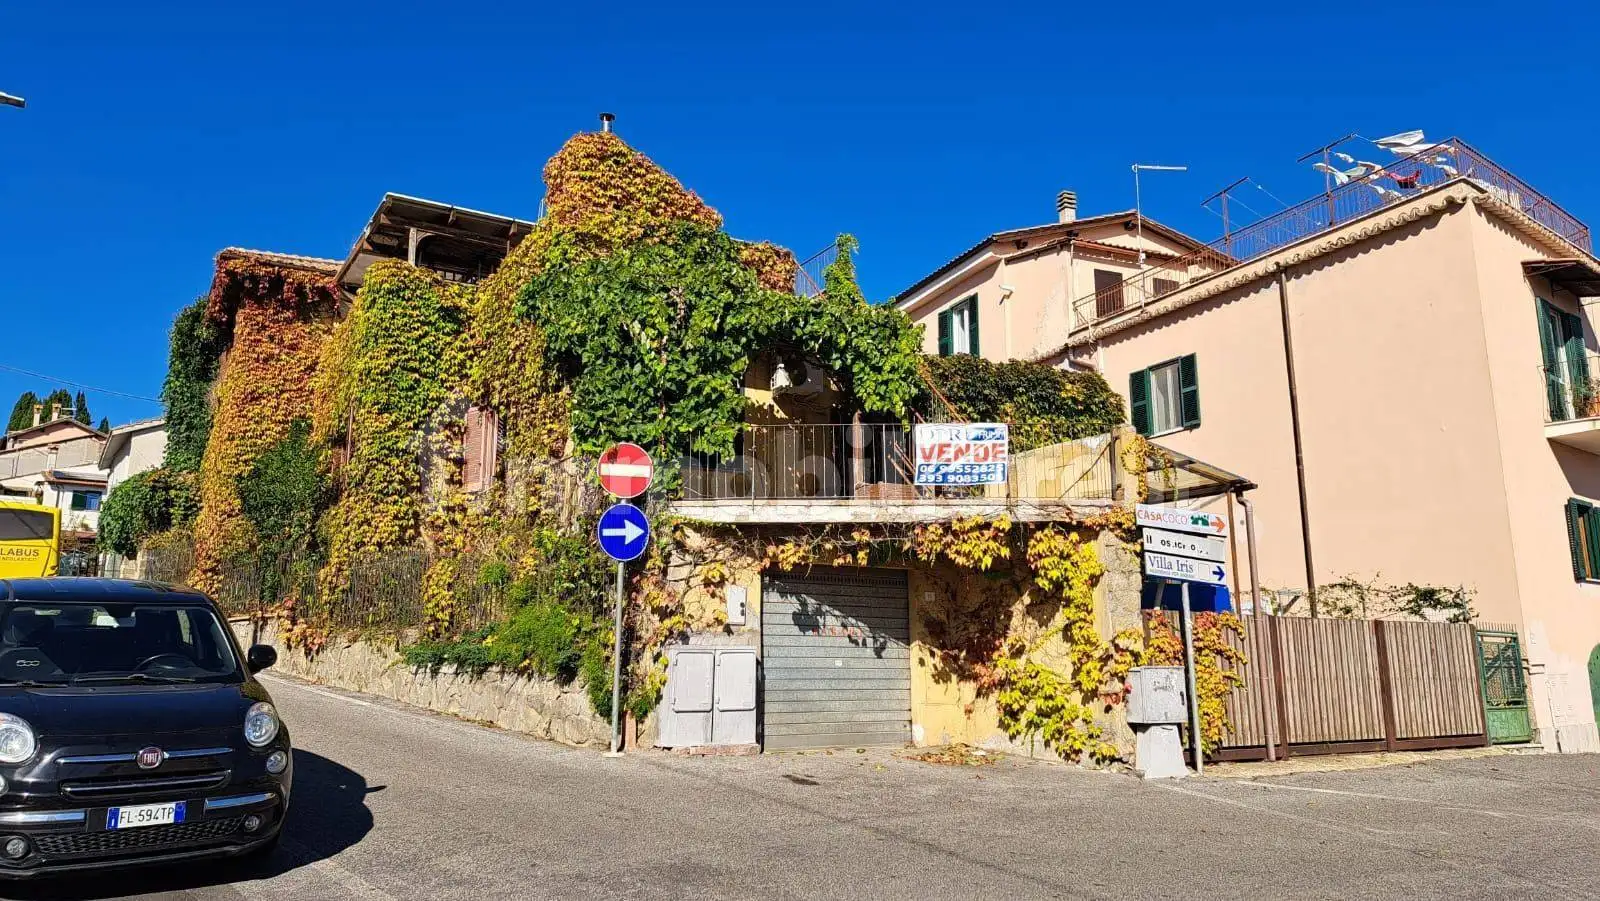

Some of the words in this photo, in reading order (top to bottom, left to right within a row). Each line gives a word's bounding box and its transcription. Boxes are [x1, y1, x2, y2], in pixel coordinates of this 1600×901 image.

[920, 443, 1005, 462] VENDE
[919, 474, 943, 482] 393
[1148, 555, 1173, 570] Villa
[1176, 559, 1194, 573] Iris
[143, 752, 158, 764] FIAT
